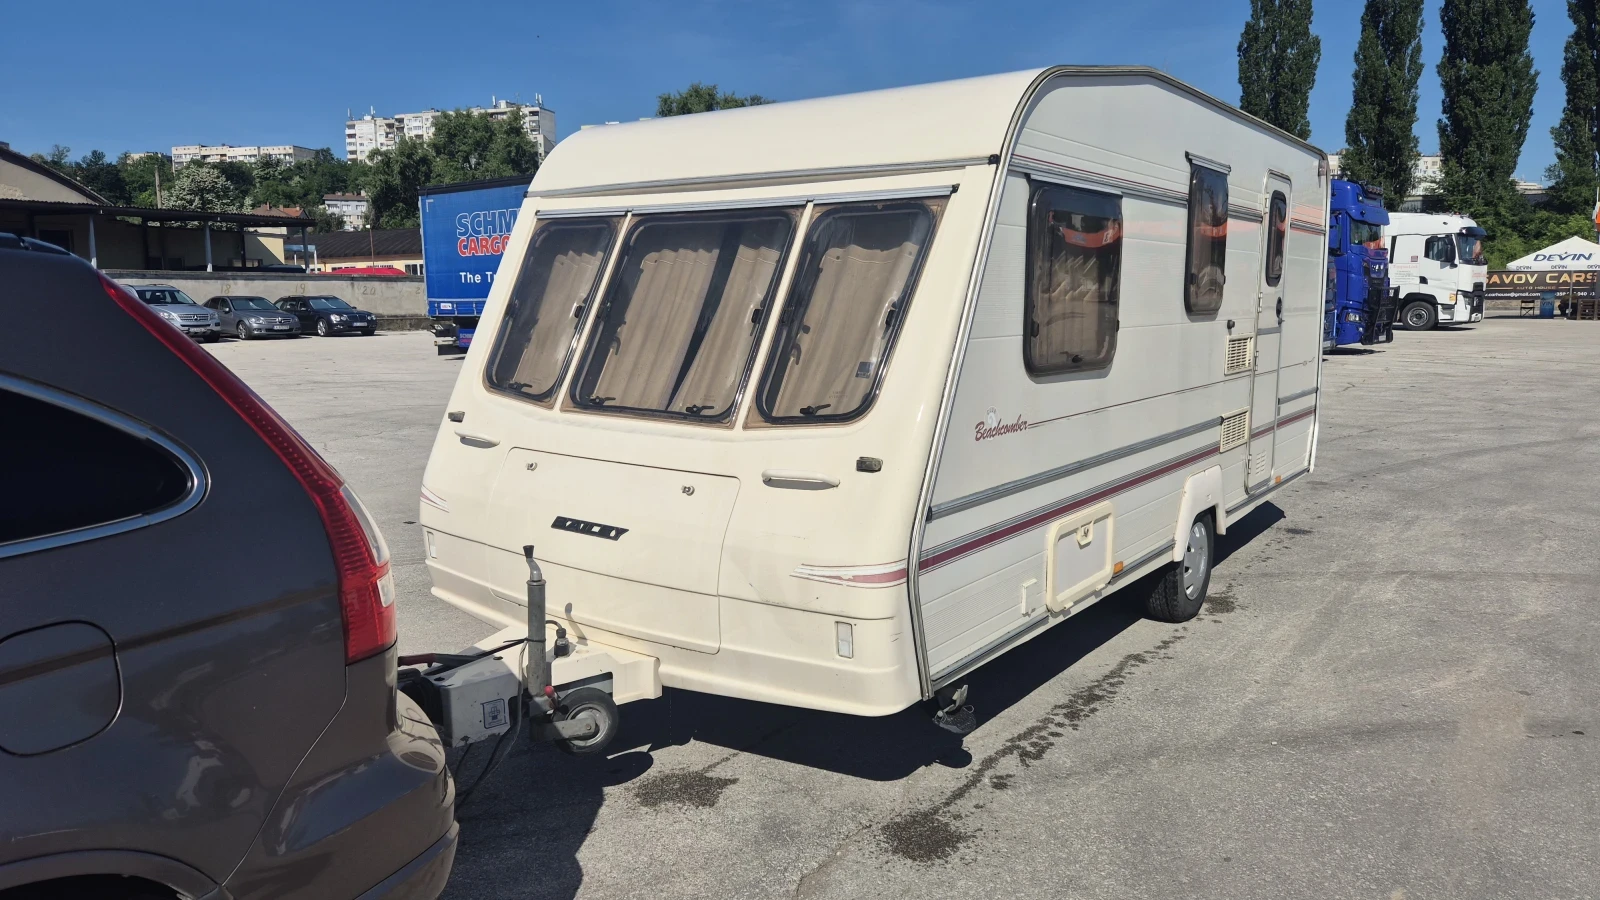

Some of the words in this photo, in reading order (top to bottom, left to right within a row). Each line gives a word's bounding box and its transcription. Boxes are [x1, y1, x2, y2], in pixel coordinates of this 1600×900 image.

[456, 208, 520, 238] SCHM
[1533, 251, 1593, 262] DEVIN
[459, 271, 482, 284] The
[221, 284, 231, 294] 18
[295, 283, 306, 294] 19
[362, 285, 376, 296] 20
[975, 414, 1027, 441] Beachcomber
